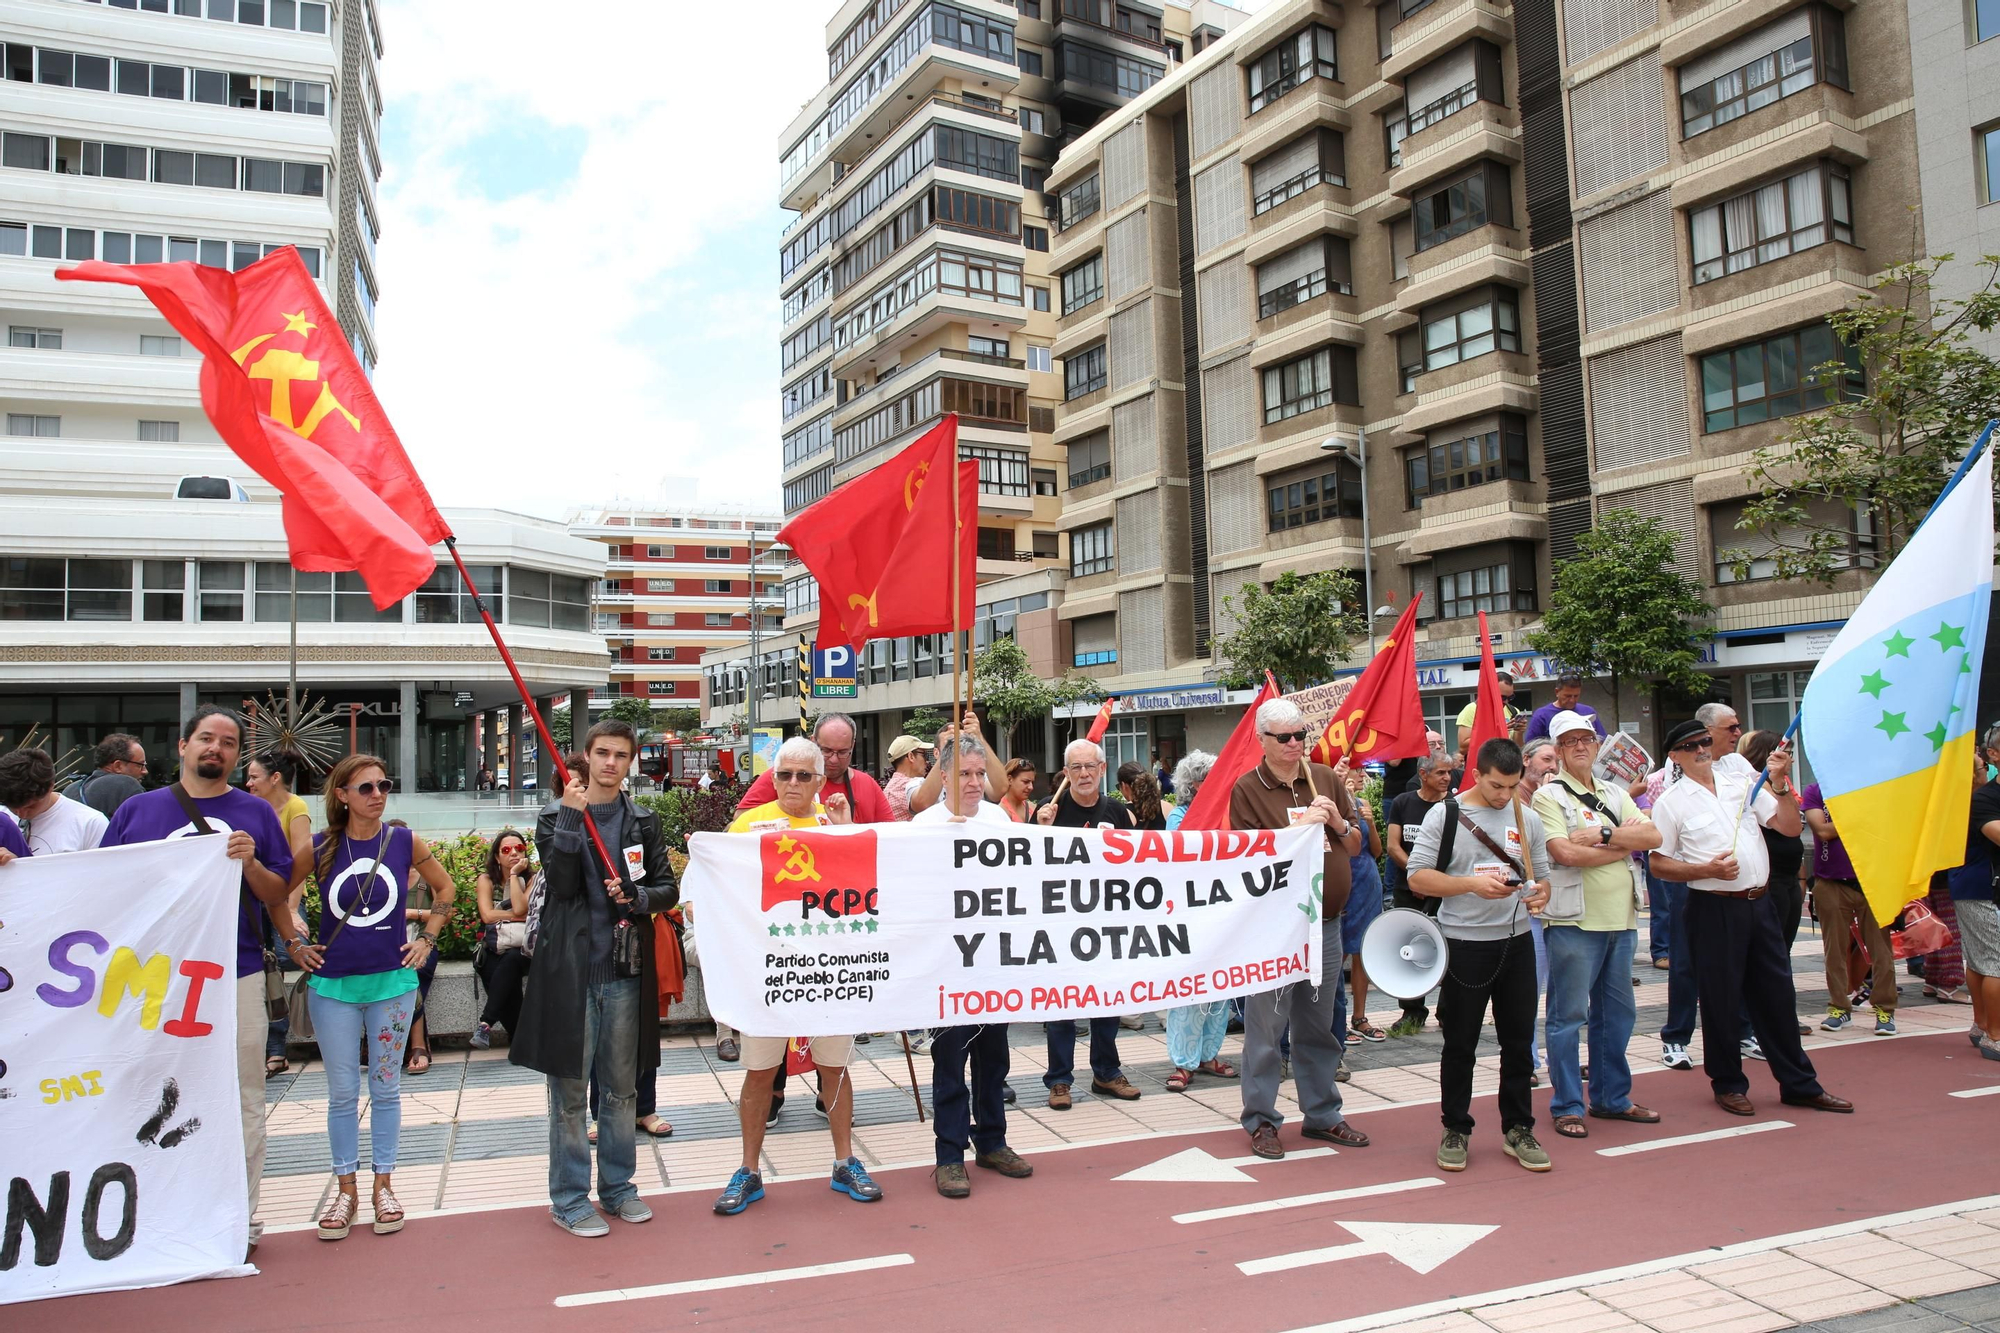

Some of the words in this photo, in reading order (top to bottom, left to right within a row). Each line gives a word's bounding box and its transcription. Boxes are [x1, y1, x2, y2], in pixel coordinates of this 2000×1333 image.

[824, 646, 848, 677] P
[1418, 668, 1449, 686] IAL
[820, 686, 849, 694] LIBRE
[1137, 695, 1170, 709] Mutua
[1171, 688, 1225, 707] Universal
[954, 837, 1031, 868] POR
[1044, 836, 1090, 865] LA
[1102, 829, 1277, 864] SALIDA
[802, 888, 879, 919] PCPC
[954, 887, 1026, 918] DEL
[1042, 876, 1175, 915] EURO,
[1186, 878, 1233, 908] LA
[1241, 859, 1293, 898] UE
[765, 953, 815, 968] Partido
[818, 950, 889, 967] Comunista
[953, 932, 985, 967] Y
[999, 929, 1057, 966] LA
[1070, 923, 1191, 962] OTAN
[36, 930, 224, 1038] SMI
[765, 971, 784, 986] del
[786, 971, 834, 985] Pueblo
[838, 968, 890, 984] Canario
[938, 984, 1023, 1019] ¡TODO
[1030, 984, 1100, 1010] PARA
[1103, 989, 1126, 1007] LA
[1129, 974, 1206, 1003] CLASE
[1212, 943, 1311, 990] OBRERA!
[765, 985, 873, 1006] (PCPC-PCPE)
[39, 1069, 105, 1104] SMI
[0, 1162, 138, 1271] NO
